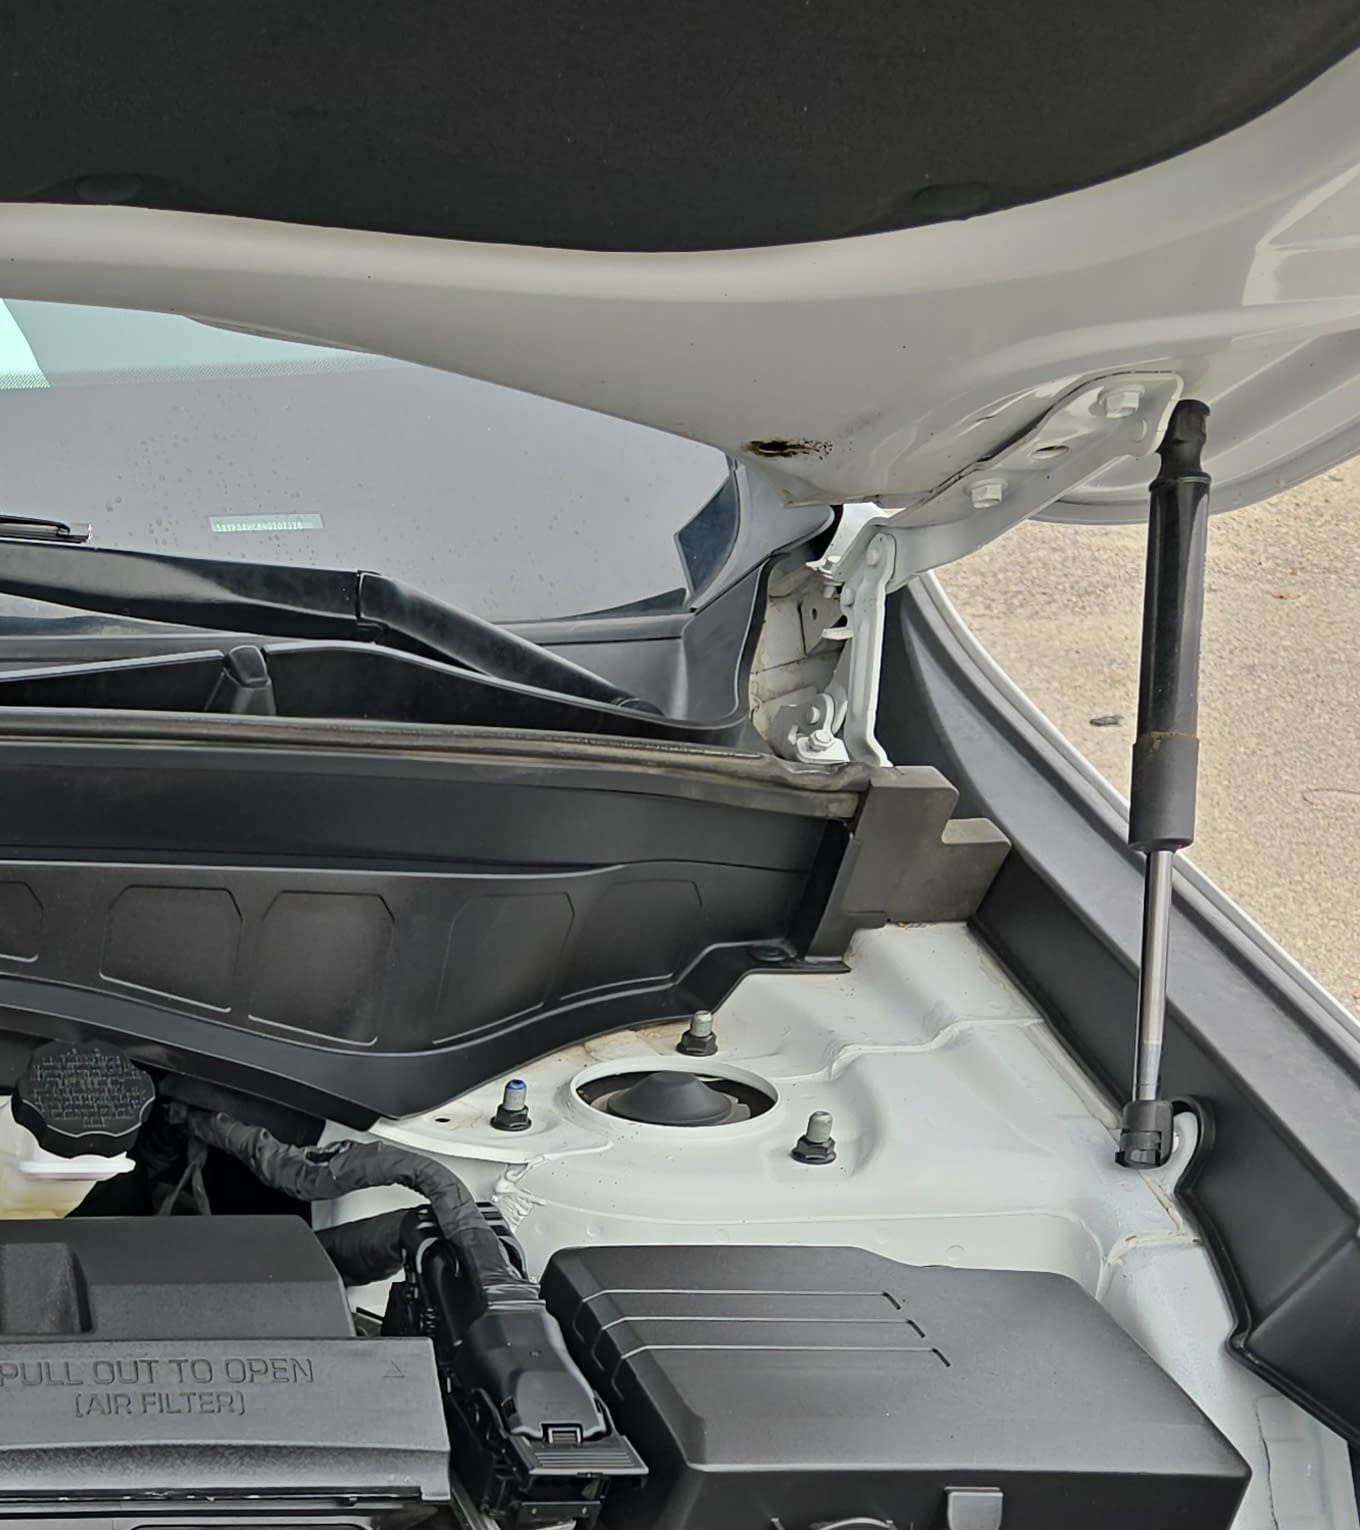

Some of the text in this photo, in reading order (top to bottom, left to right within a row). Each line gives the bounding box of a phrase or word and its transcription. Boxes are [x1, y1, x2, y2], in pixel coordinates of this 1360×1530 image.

[92, 1358, 159, 1386] OUT
[168, 1357, 215, 1385] TO
[224, 1356, 315, 1384] OPEN
